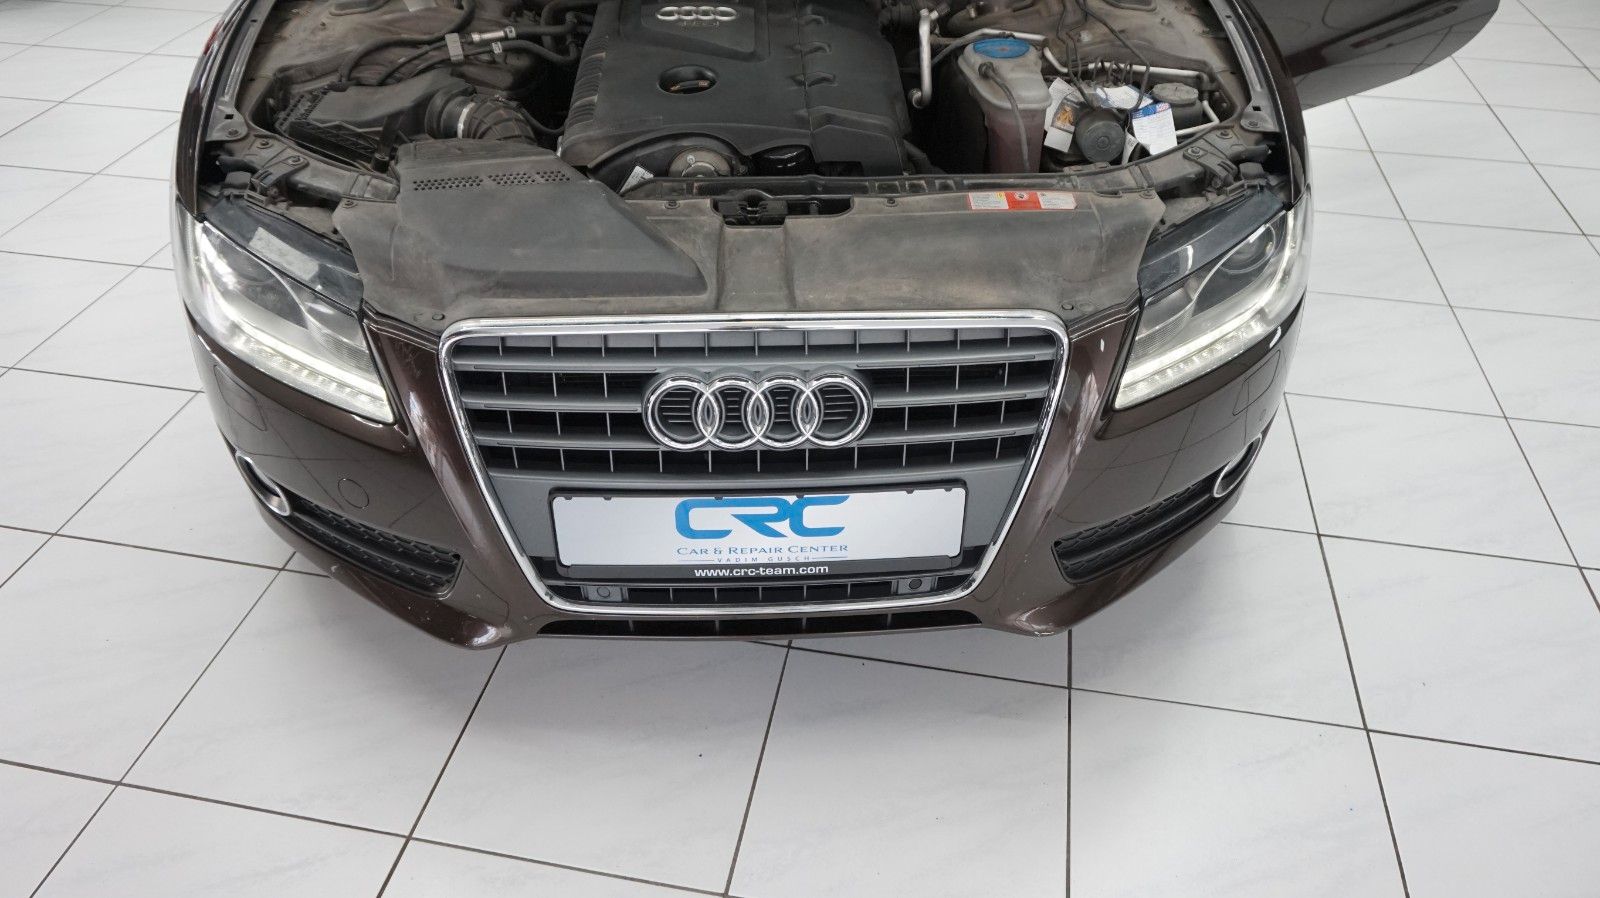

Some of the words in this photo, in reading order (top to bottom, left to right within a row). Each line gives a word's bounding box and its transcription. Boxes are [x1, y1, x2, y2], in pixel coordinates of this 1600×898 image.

[675, 495, 850, 540] CRC
[677, 547, 709, 555] CAR
[713, 546, 723, 555] &
[728, 546, 784, 555] REPAIR
[788, 544, 849, 553] CENTER
[694, 566, 829, 577] www.crc-team.com
